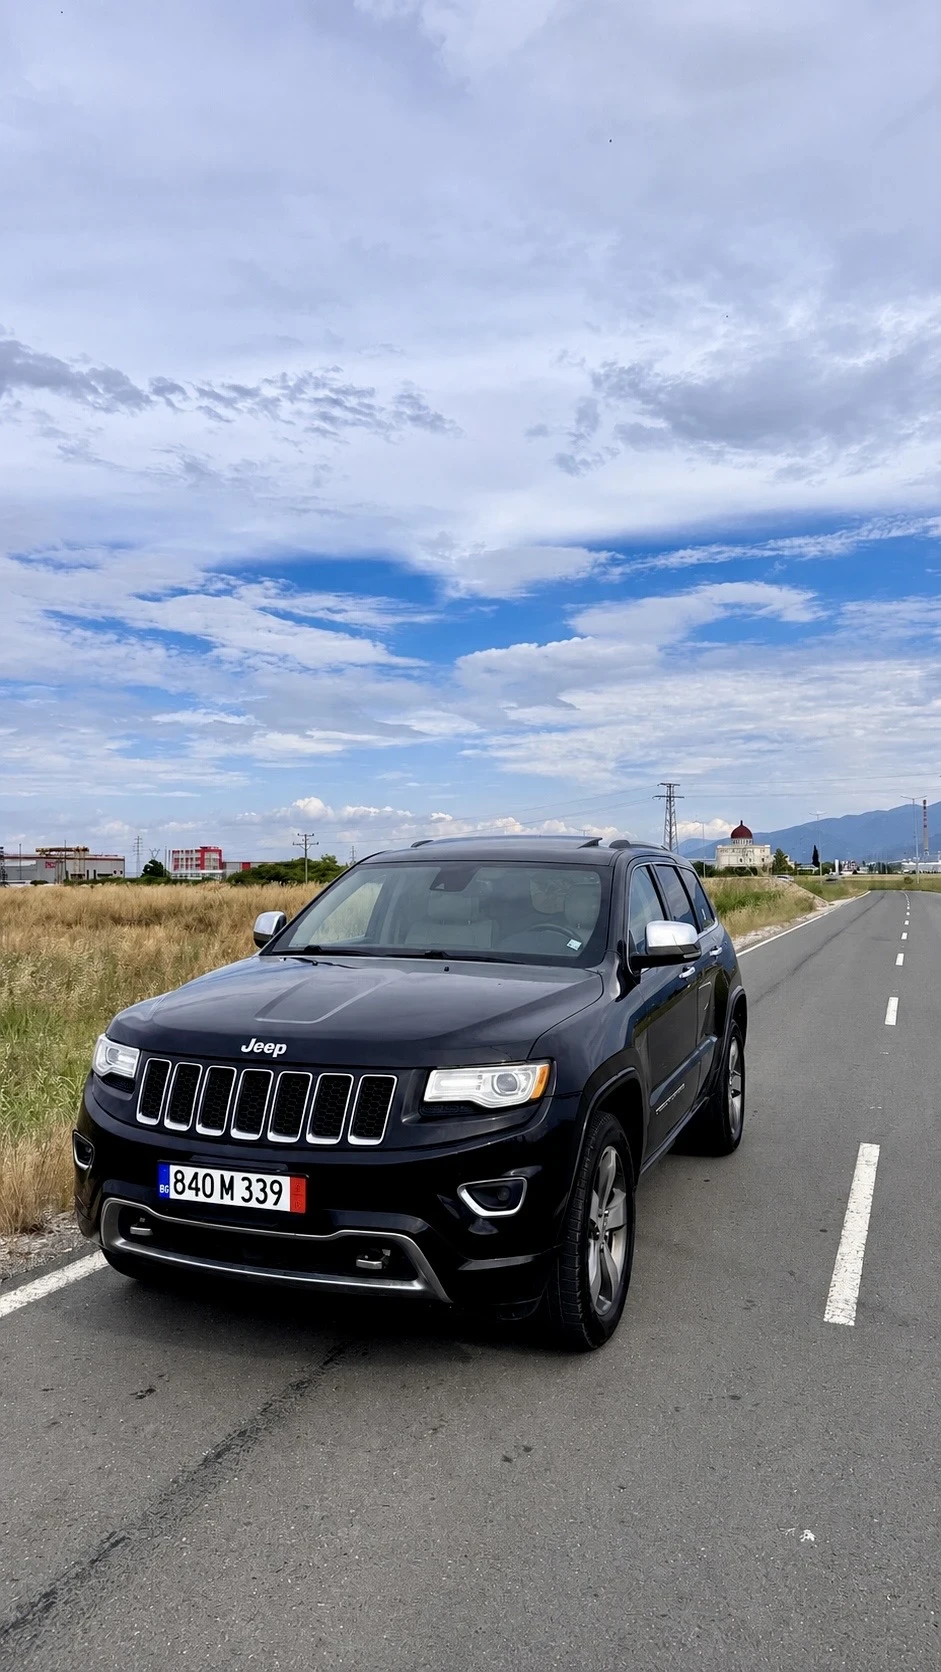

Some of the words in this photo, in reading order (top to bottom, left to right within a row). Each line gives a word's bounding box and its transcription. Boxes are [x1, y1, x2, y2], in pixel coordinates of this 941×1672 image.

[241, 1038, 287, 1058] Jeep
[159, 1184, 170, 1194] BG
[173, 1169, 215, 1199] 840
[219, 1173, 235, 1201] M
[240, 1176, 283, 1206] 339
